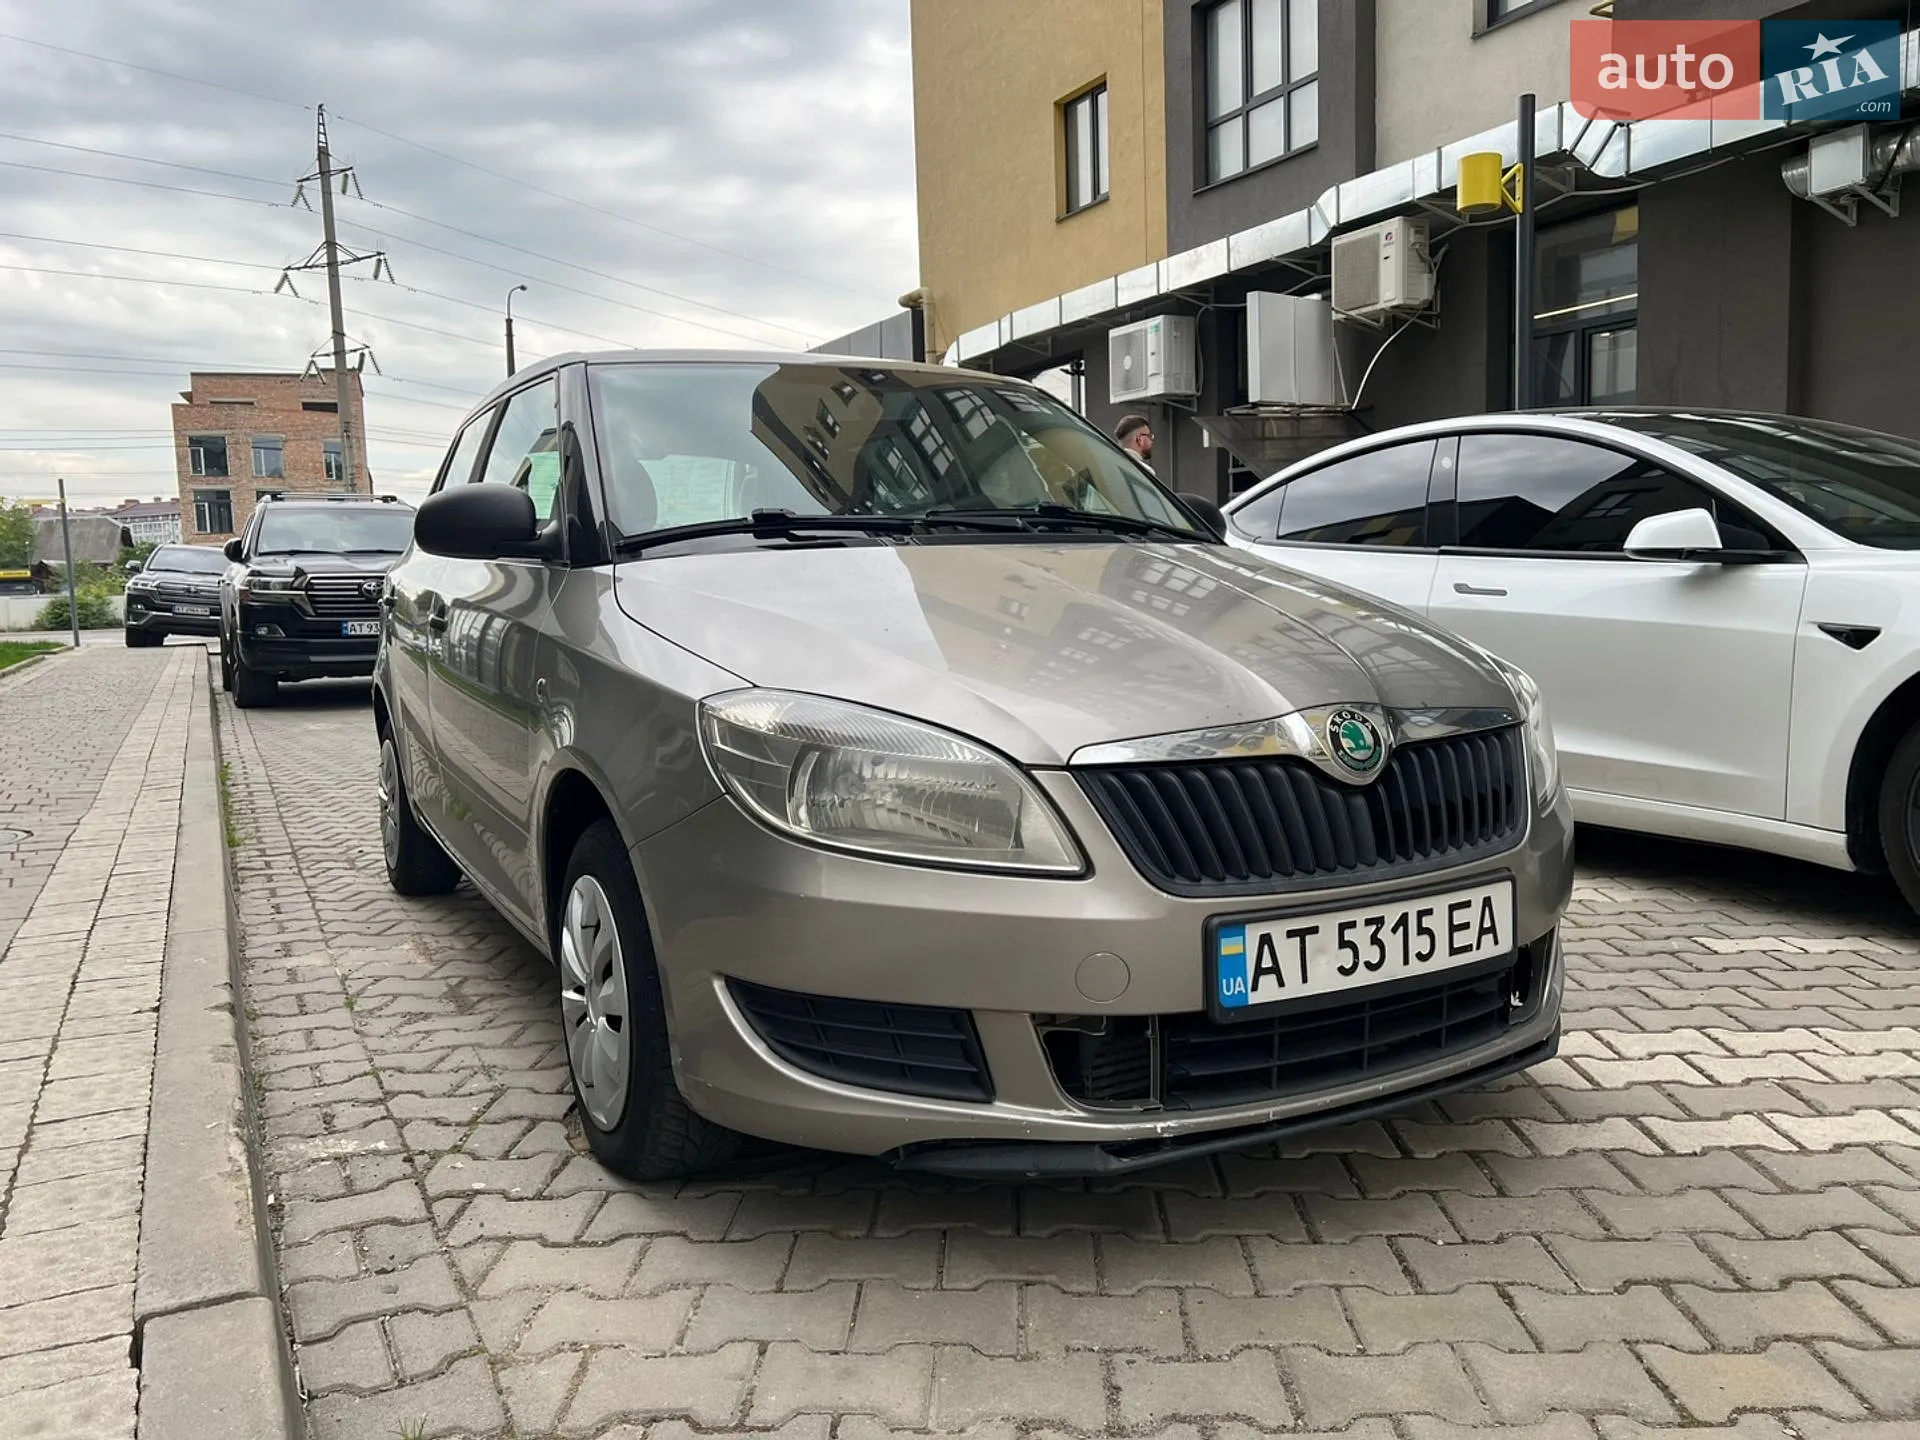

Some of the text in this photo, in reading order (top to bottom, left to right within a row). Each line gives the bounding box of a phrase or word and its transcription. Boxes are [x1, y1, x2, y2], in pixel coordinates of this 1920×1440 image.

[349, 623, 365, 633] AT
[1250, 896, 1500, 992] AT 5315 EA
[1222, 976, 1246, 996] UA
